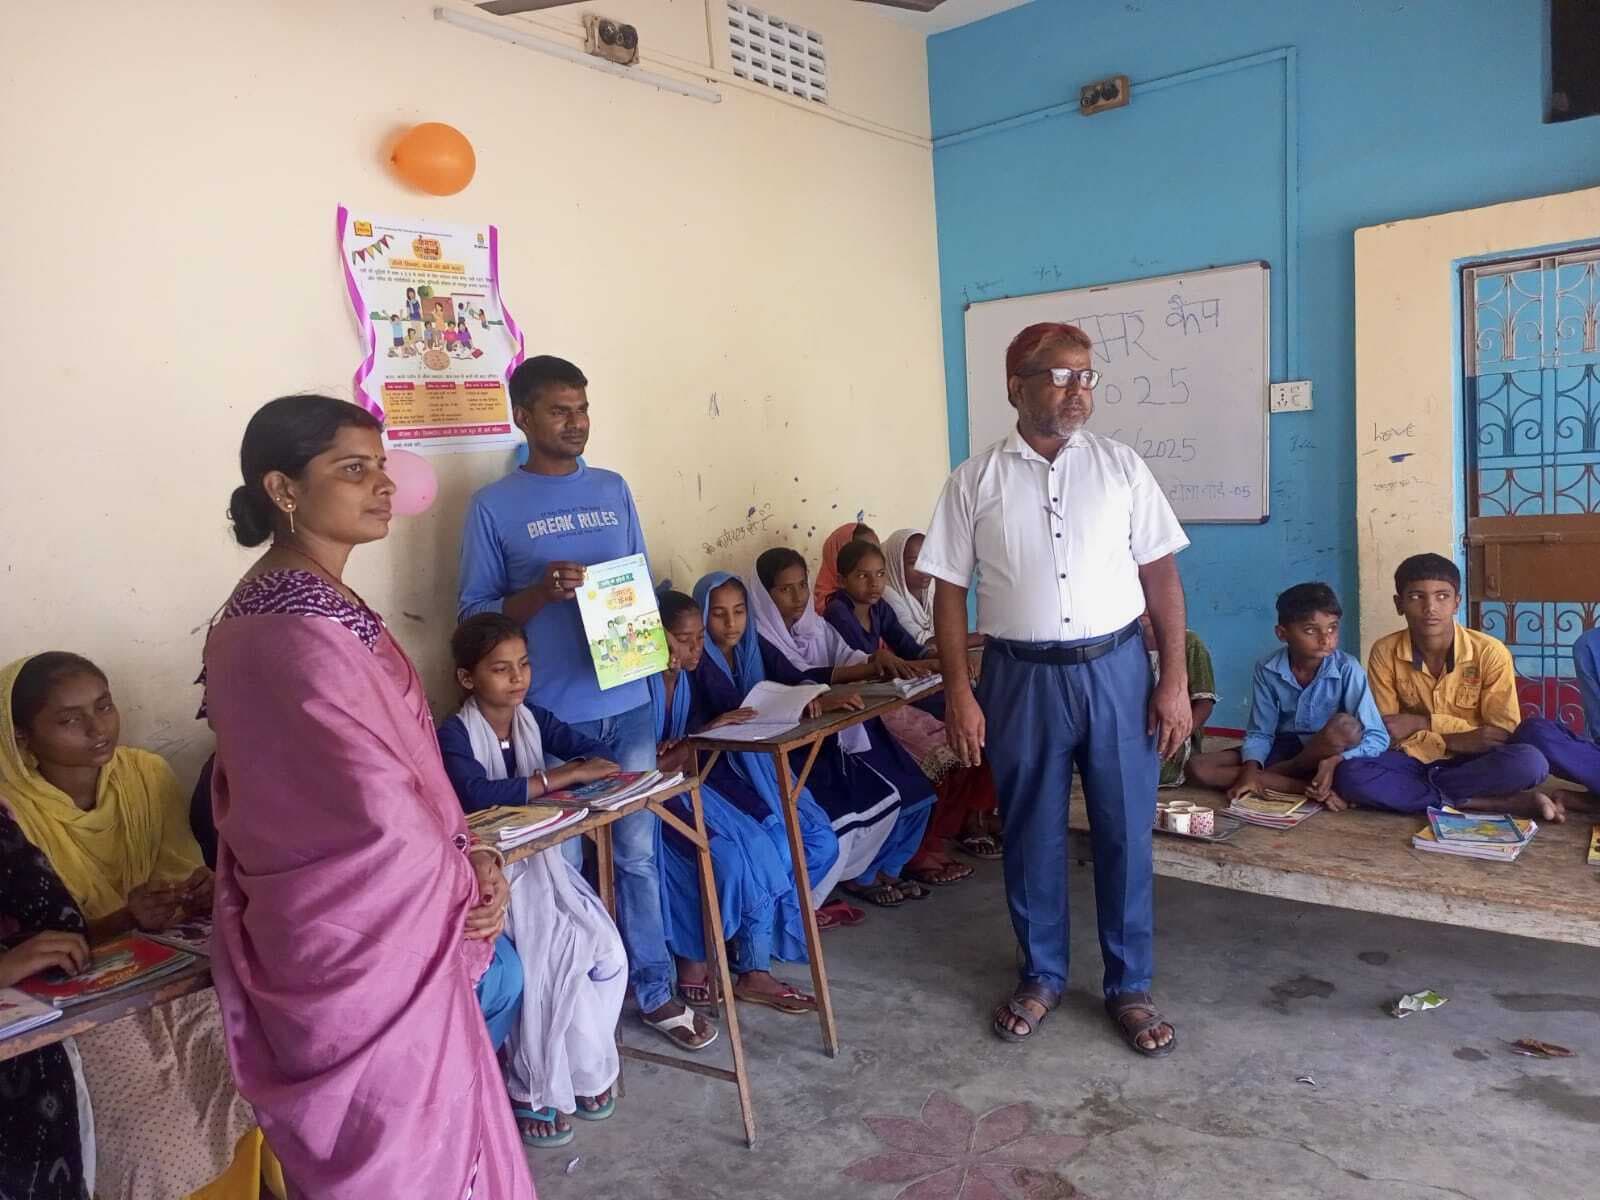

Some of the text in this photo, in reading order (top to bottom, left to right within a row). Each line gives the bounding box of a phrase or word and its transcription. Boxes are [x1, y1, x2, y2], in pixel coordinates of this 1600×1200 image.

[1103, 367, 1191, 405] 025
[527, 513, 577, 539] BREAK
[577, 511, 619, 529] RULES
